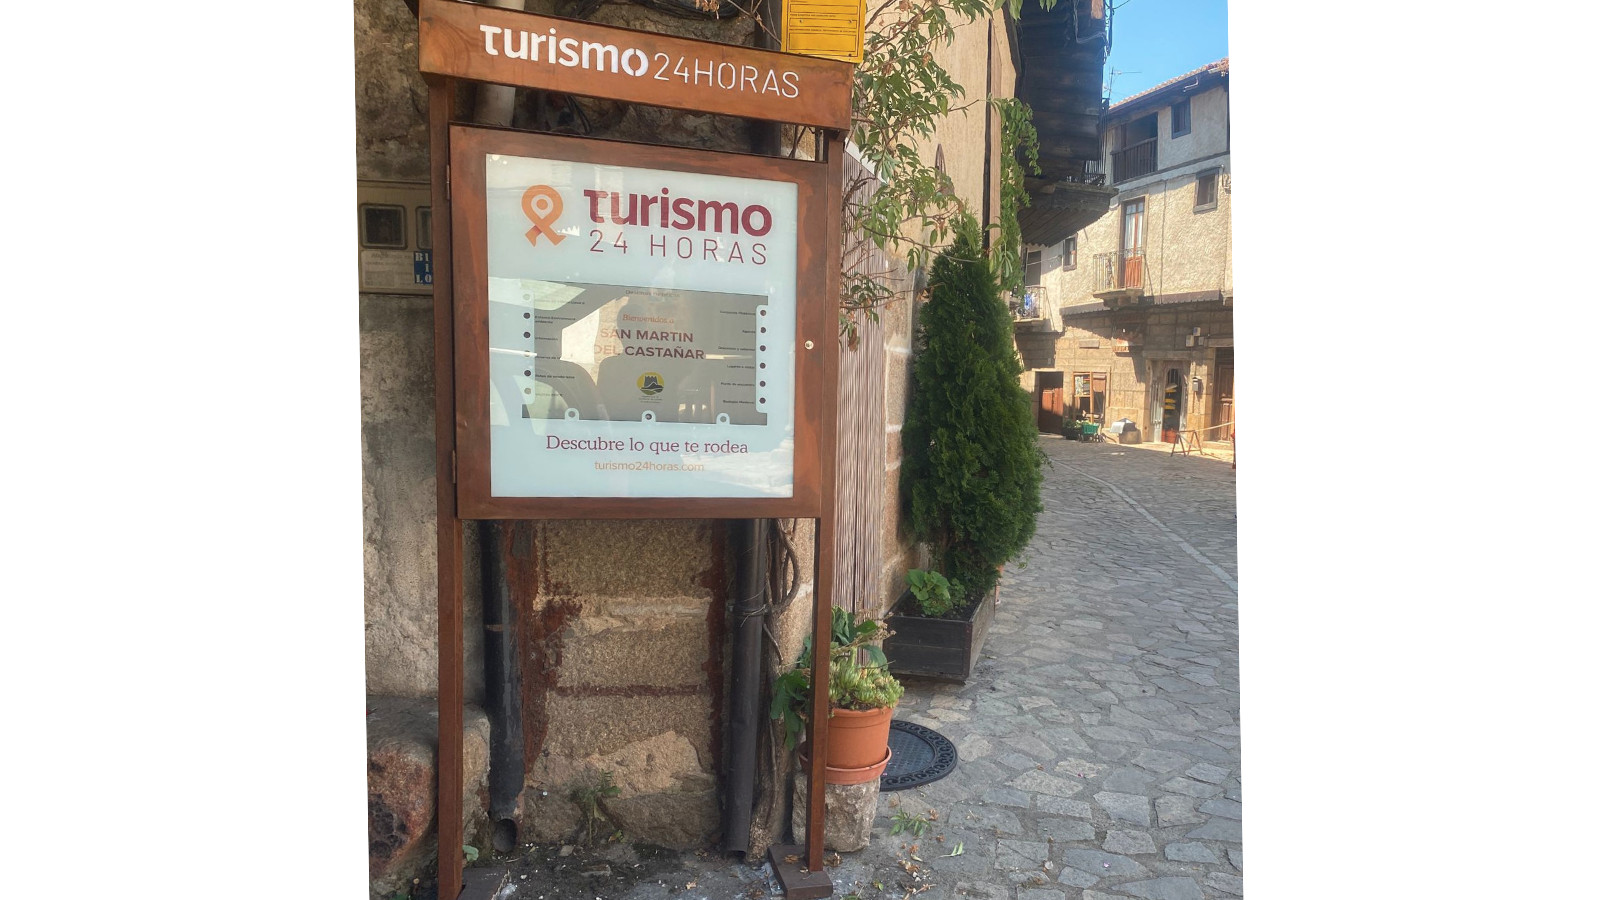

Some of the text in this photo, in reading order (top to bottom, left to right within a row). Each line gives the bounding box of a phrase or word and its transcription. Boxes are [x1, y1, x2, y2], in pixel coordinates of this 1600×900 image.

[589, 229, 767, 265] 24 HORAS
[600, 328, 694, 343] SAN MARTIN
[594, 344, 621, 356] DEL
[624, 345, 705, 360] CASTAÑAR
[546, 435, 748, 455] Descubre lo que te rodea
[594, 461, 705, 472] turismo24horas.com
